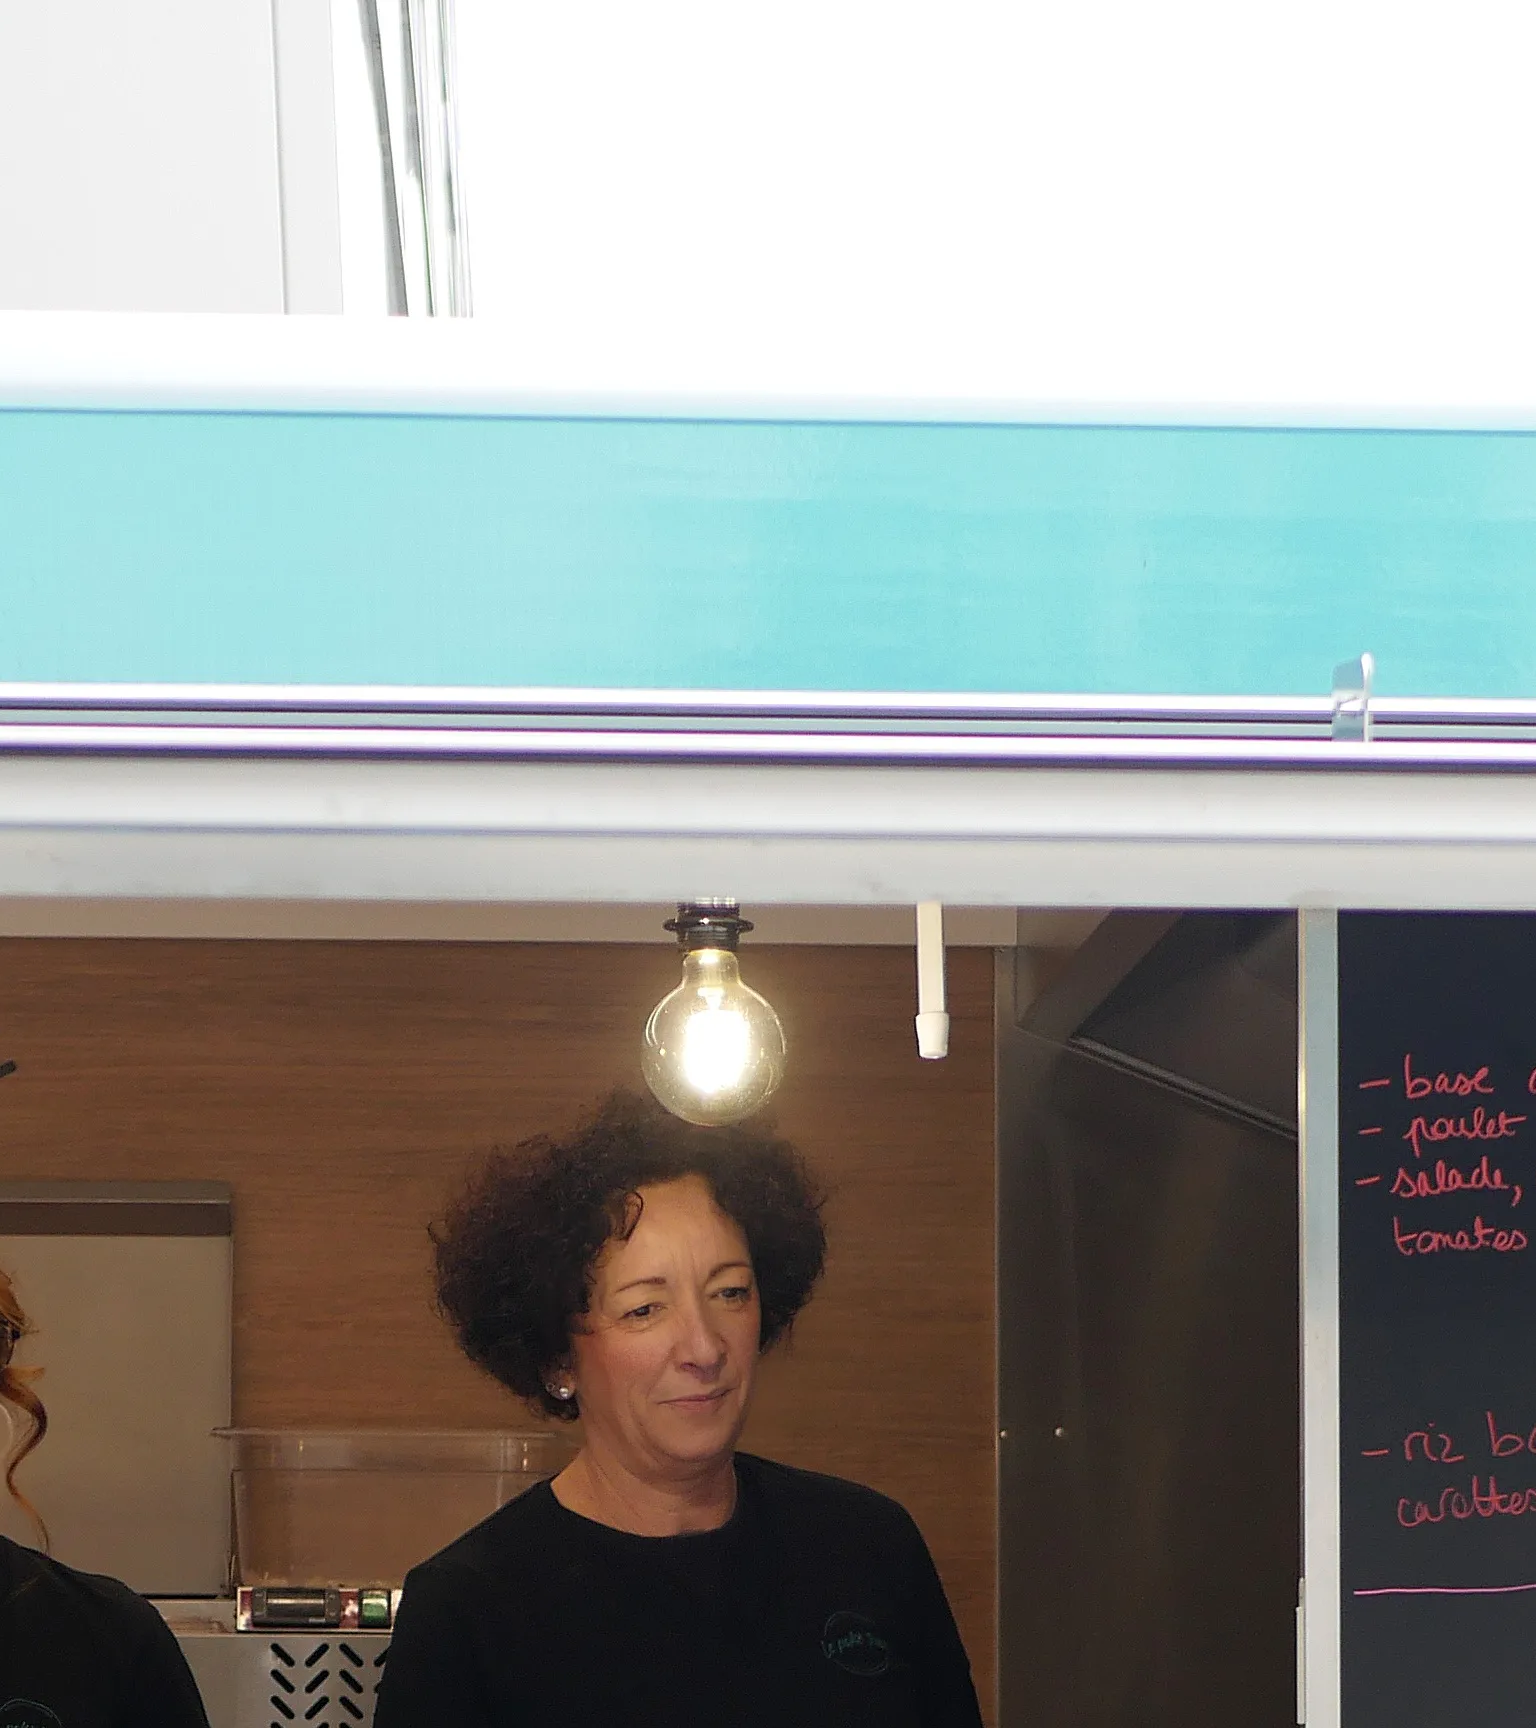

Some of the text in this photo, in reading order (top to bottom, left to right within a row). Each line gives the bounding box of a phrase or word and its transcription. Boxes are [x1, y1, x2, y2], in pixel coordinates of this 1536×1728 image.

[1403, 1054, 1494, 1098] base
[1402, 1108, 1526, 1157] poulet
[1393, 1216, 1528, 1257] tomates
[1402, 1421, 1465, 1463] riz
